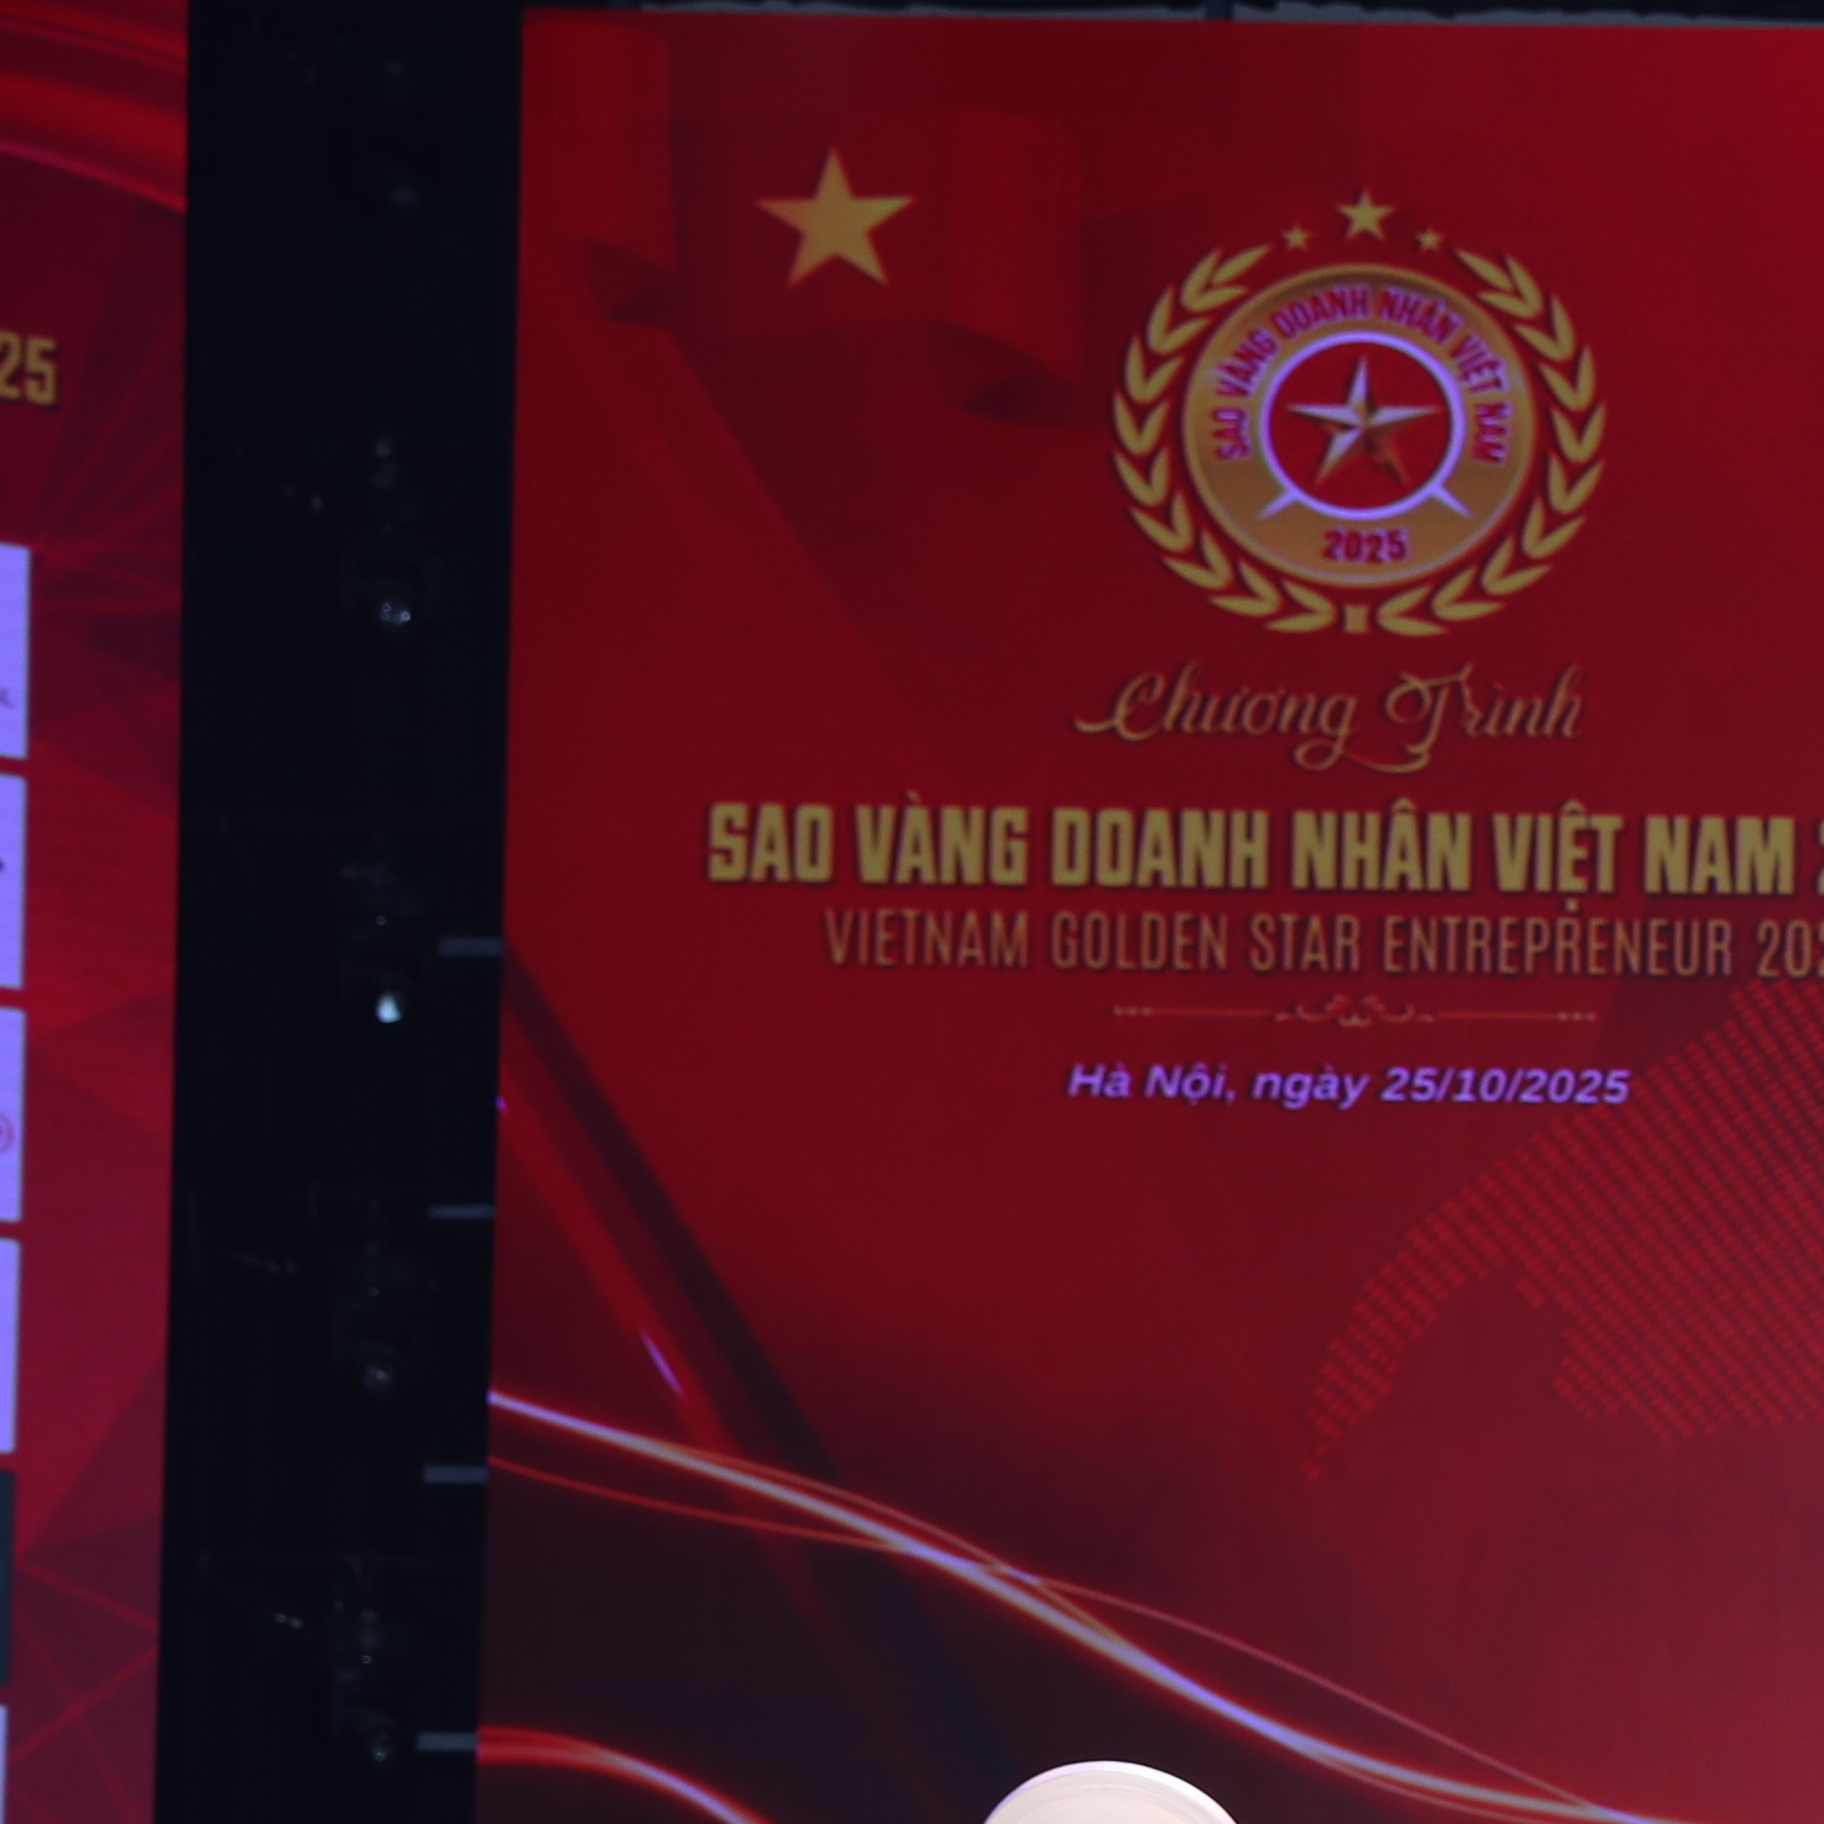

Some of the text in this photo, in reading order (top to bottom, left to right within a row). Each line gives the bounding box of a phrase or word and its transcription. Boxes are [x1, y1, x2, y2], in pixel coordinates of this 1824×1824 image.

[1321, 527, 1410, 563] 2025
[1074, 660, 1584, 771] Chương Trình
[708, 803, 833, 882] SAO
[855, 792, 1027, 885] VÀNG
[1051, 805, 1269, 889] DOANH
[1291, 797, 1472, 891] NHÂN
[1492, 800, 1624, 912] VIỆT
[1643, 813, 1796, 895] NAM
[822, 907, 1028, 967] VIETNAM
[1050, 910, 1230, 970] GOLDEN
[1249, 913, 1362, 973] STAR
[1383, 915, 1733, 978] ENTREPRENEUR
[1067, 1062, 1631, 1110] Hà Nội, ngày 25/10/2025
